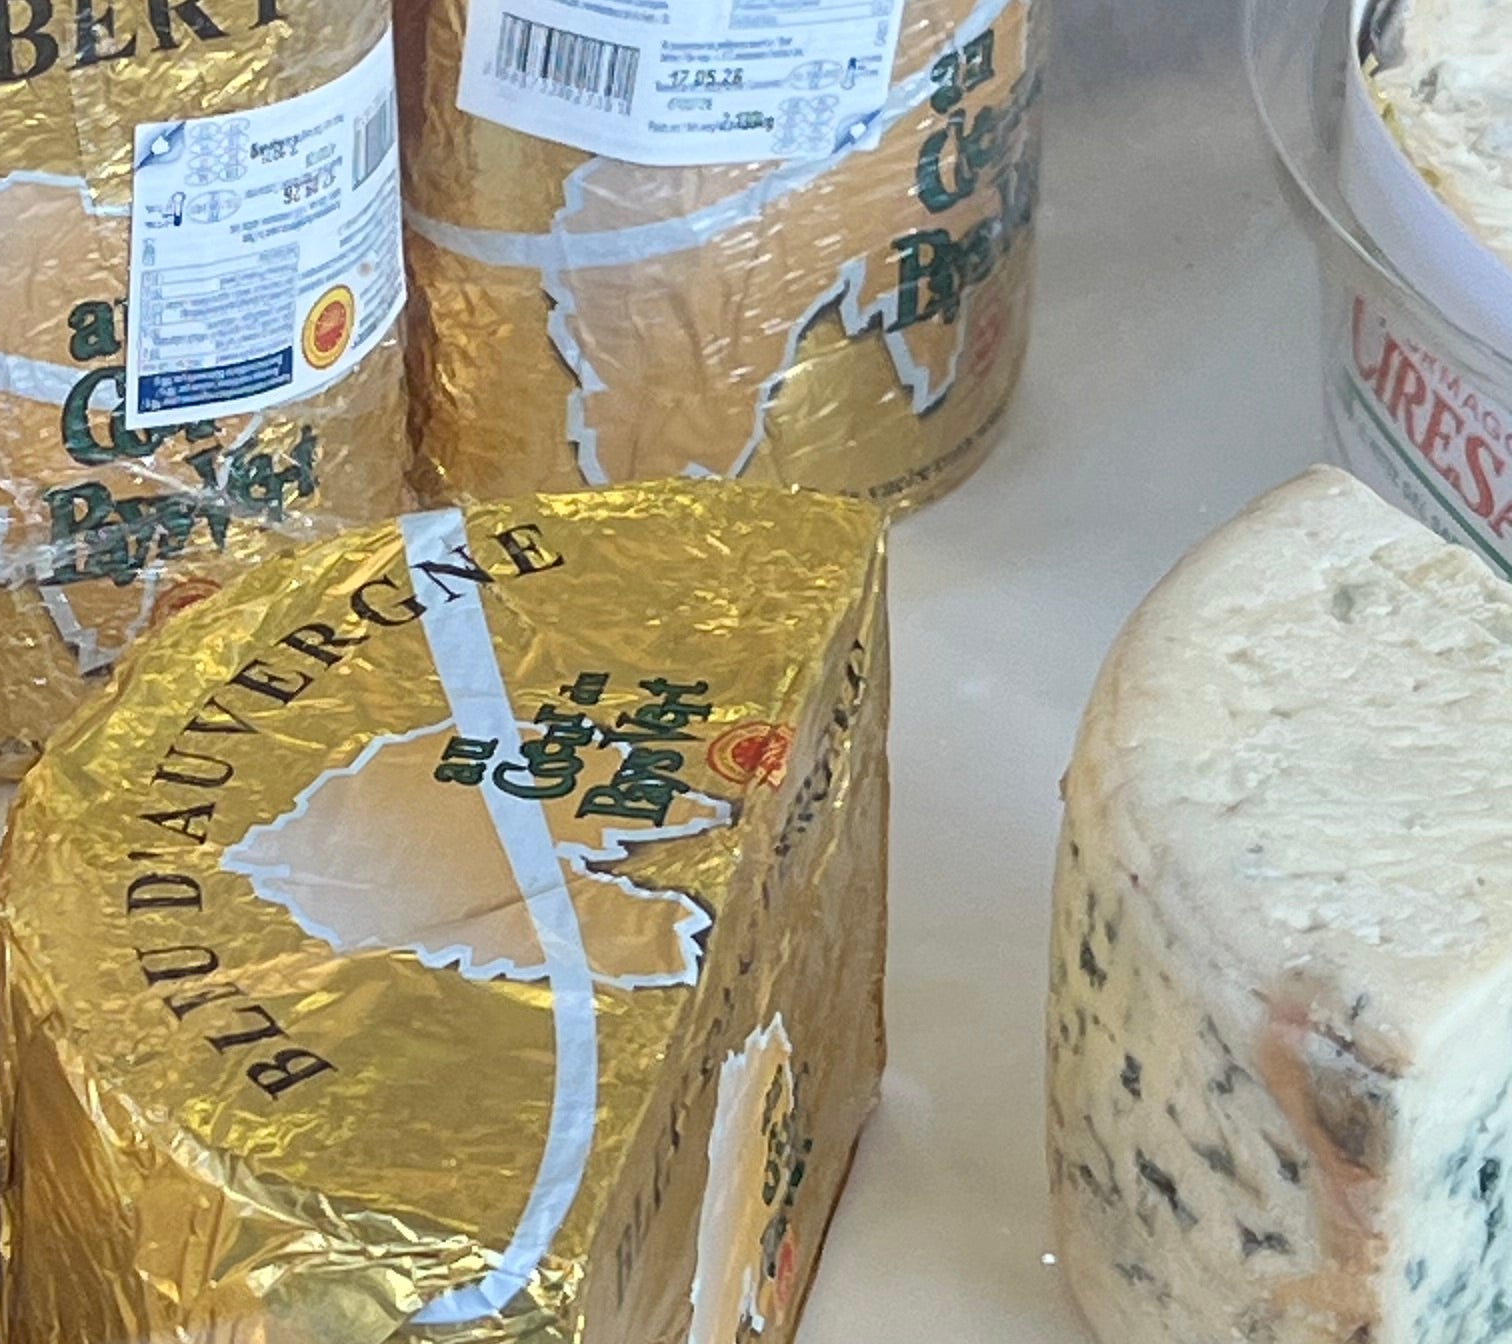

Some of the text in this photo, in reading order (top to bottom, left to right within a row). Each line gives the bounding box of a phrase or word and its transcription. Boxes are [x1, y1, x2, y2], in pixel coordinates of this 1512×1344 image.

[125, 521, 568, 914] D'AUVERGNE
[433, 736, 500, 786] au
[573, 676, 714, 828] Pays Vert
[134, 942, 340, 1103] BLEU
